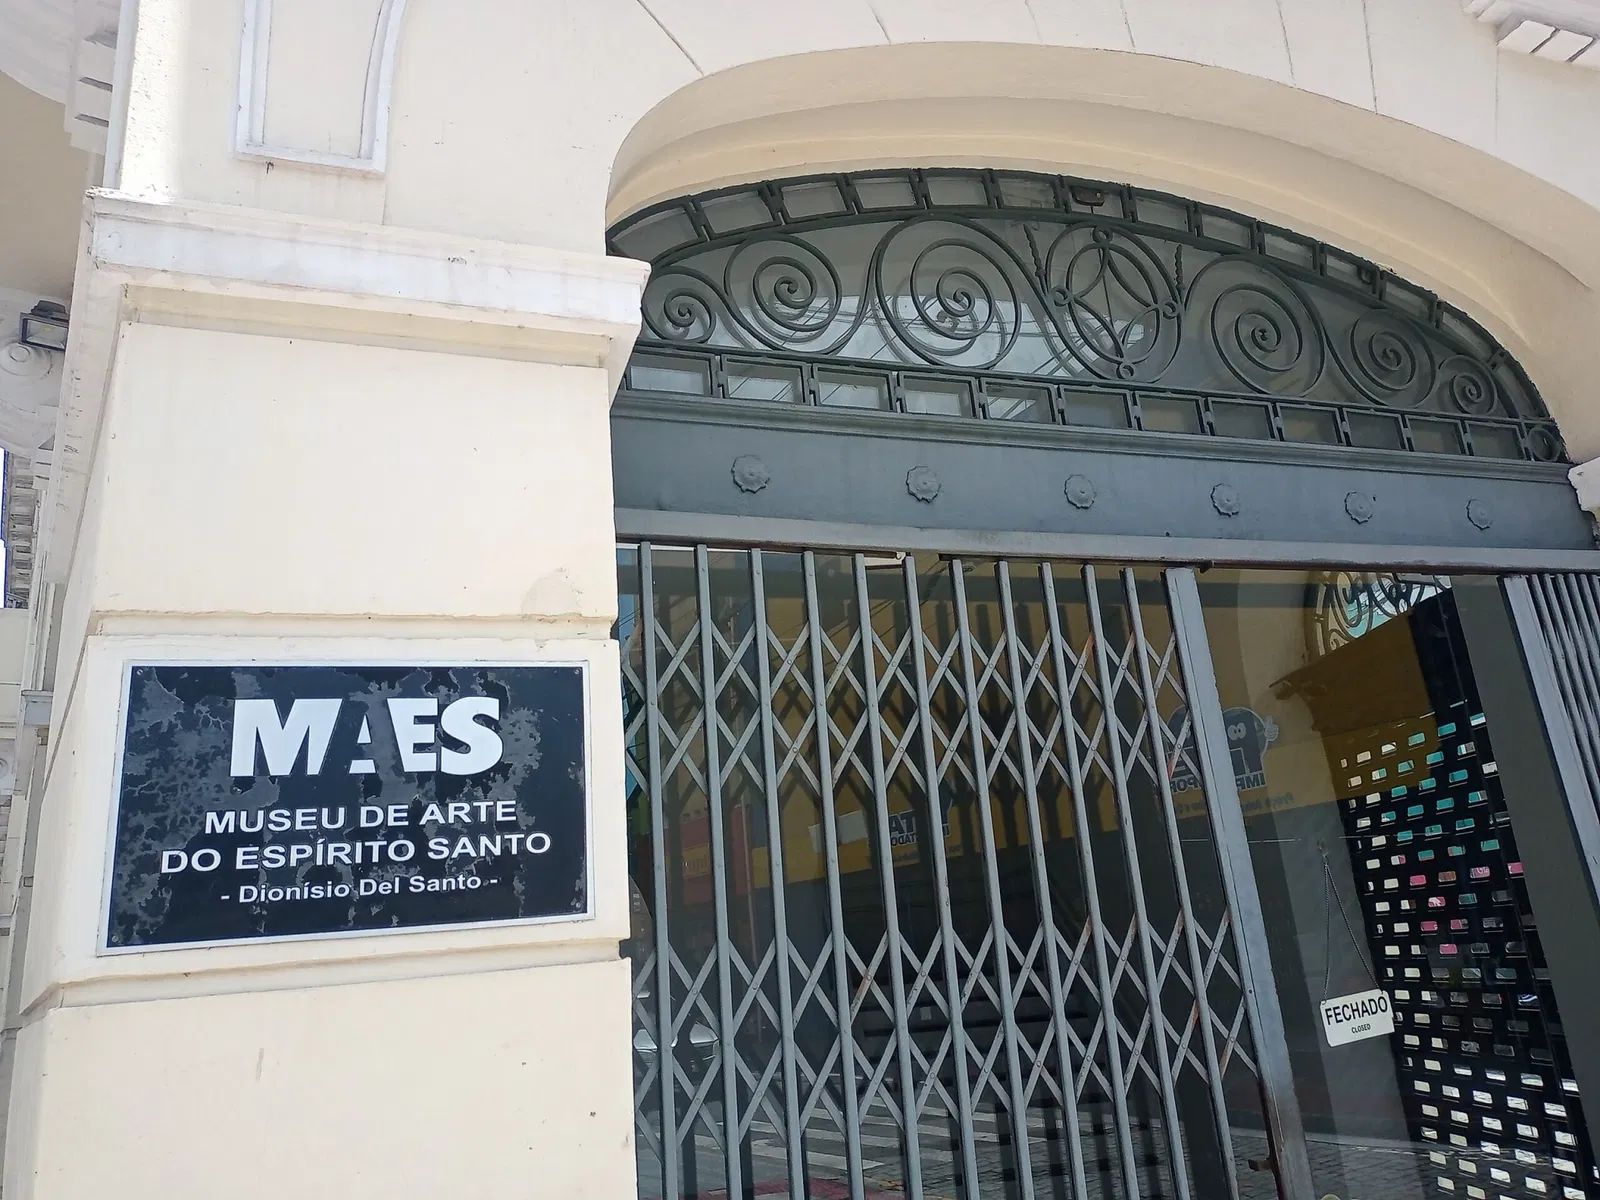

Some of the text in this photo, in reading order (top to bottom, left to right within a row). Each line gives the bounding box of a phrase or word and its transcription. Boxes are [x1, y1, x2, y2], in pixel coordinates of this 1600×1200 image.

[230, 696, 504, 778] MAES
[205, 800, 517, 835] MUSEU DE ARTE
[161, 832, 552, 875] DO ESPÍRITO SANTO
[239, 878, 350, 904] Dionísio
[359, 876, 399, 897] Del
[409, 873, 482, 894] Santo
[1325, 996, 1388, 1025] FECHADO
[1351, 1023, 1371, 1034] CLOSED
